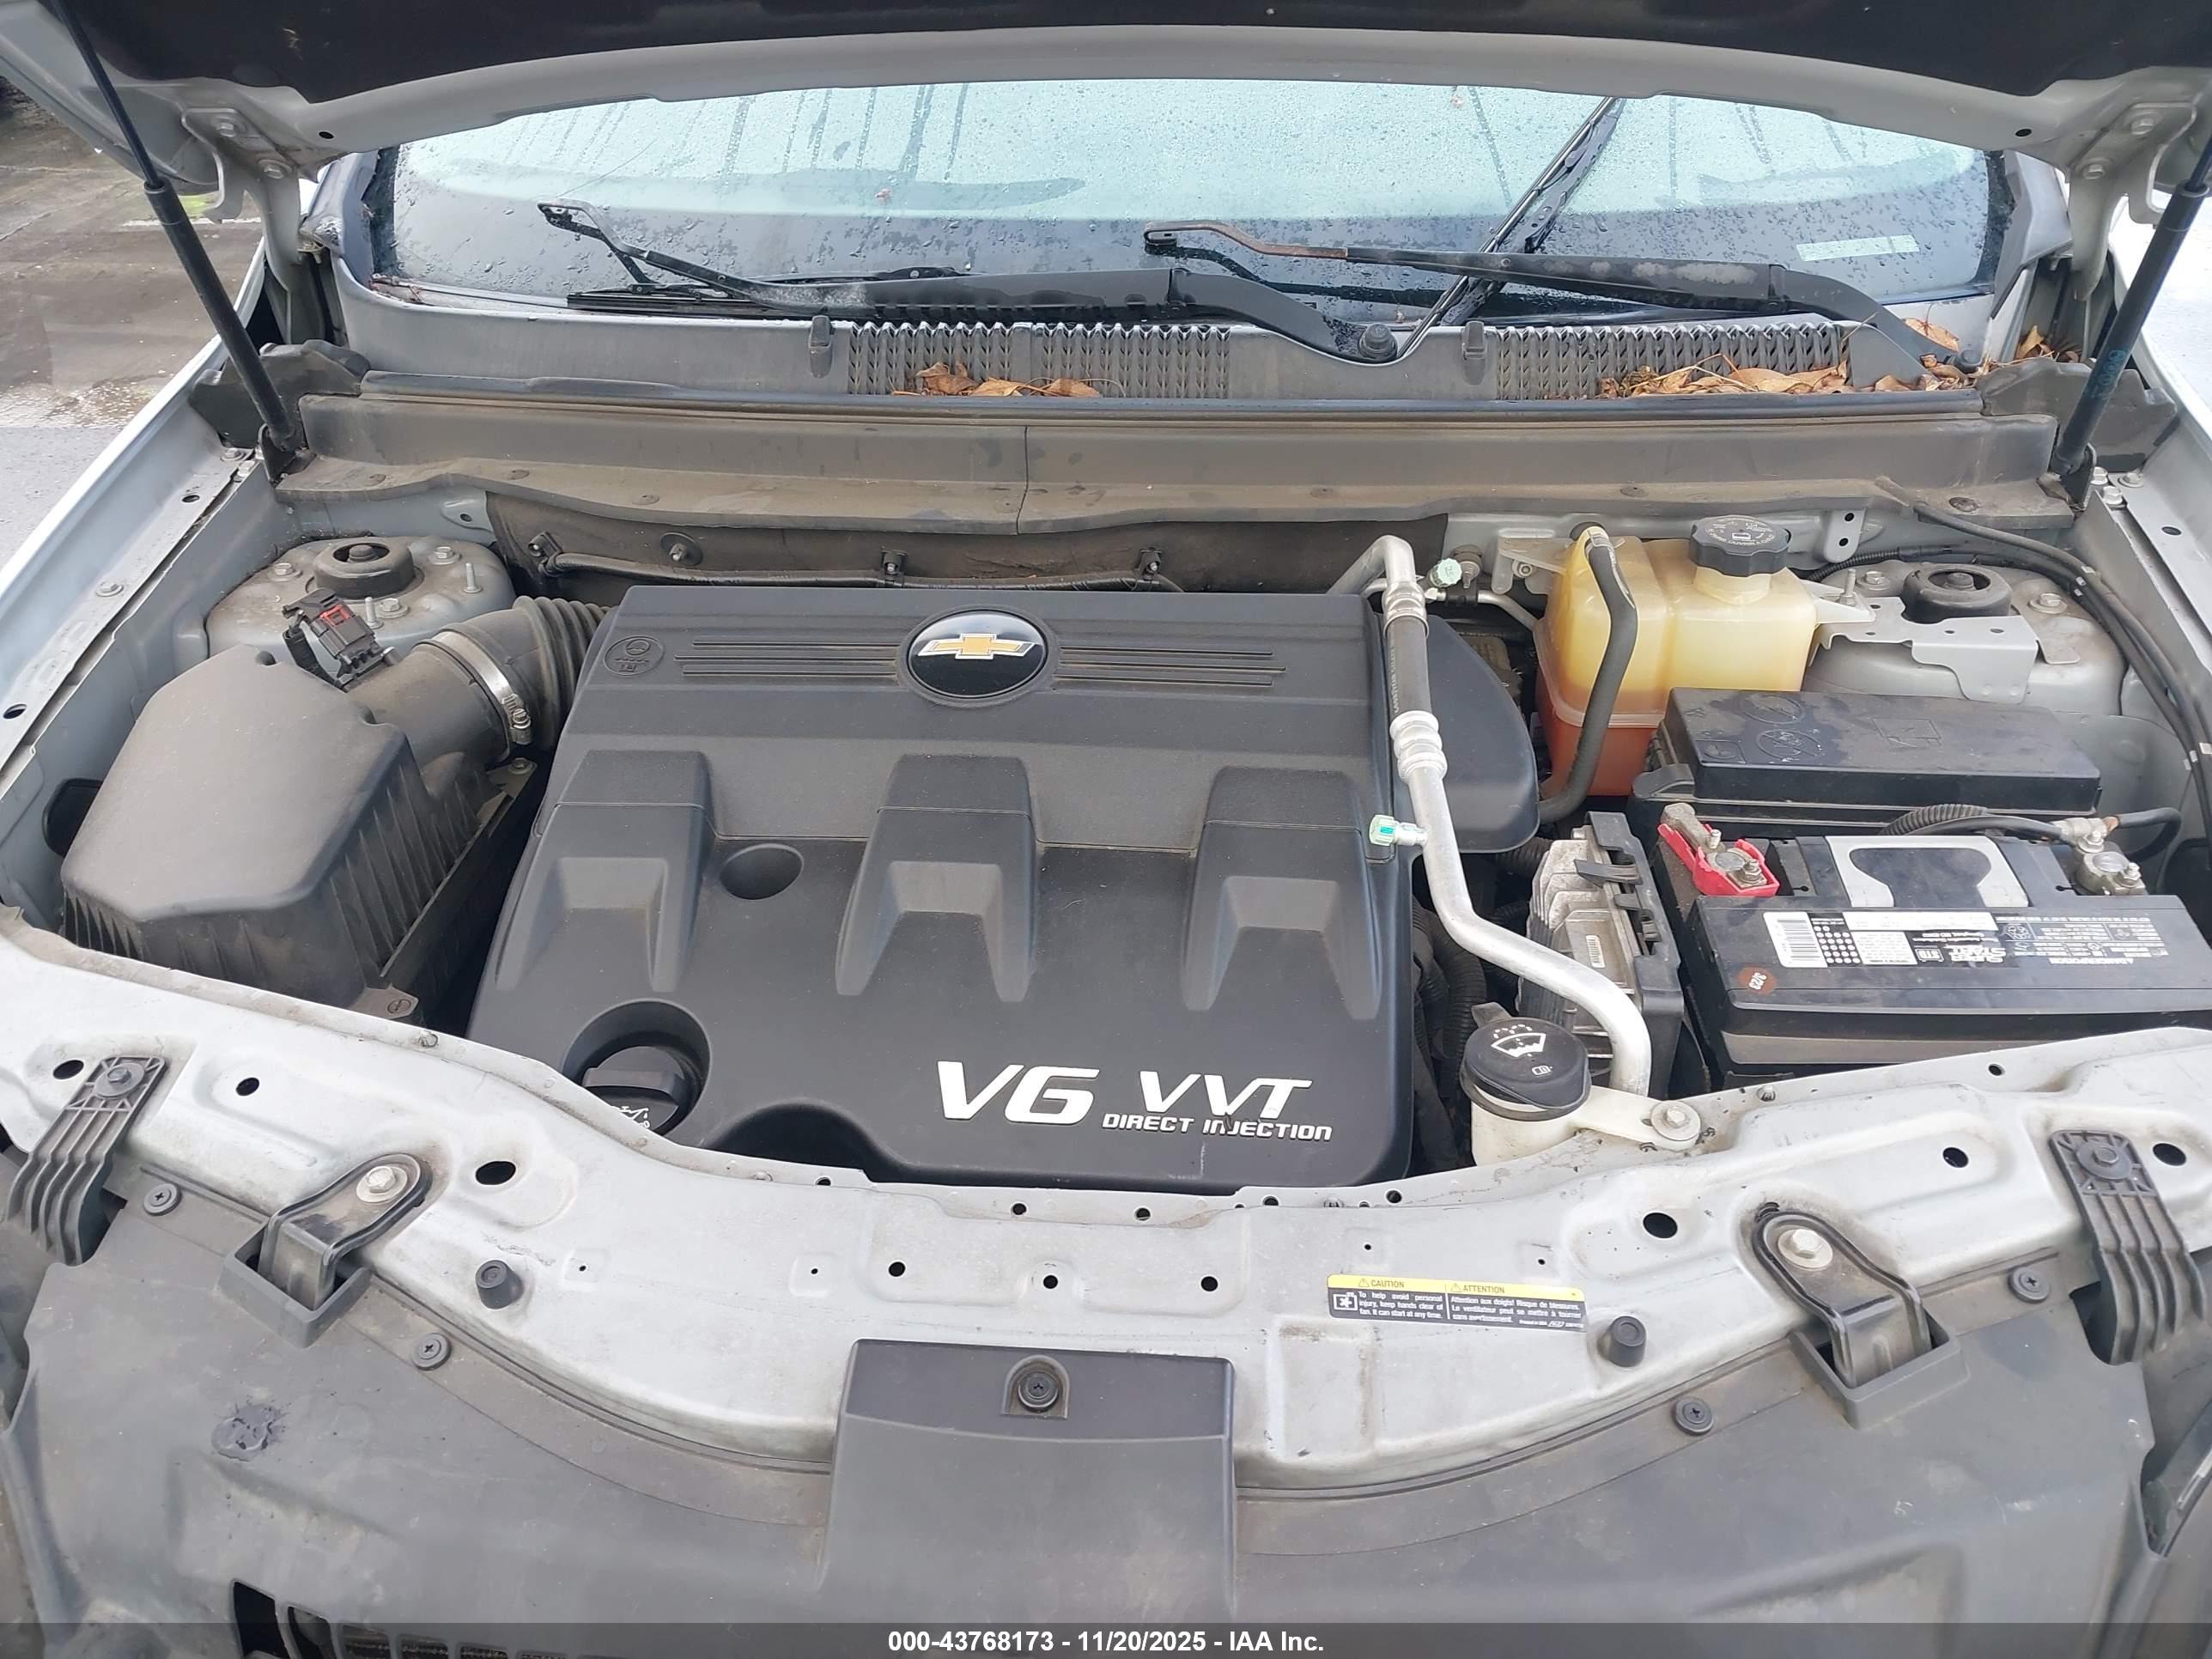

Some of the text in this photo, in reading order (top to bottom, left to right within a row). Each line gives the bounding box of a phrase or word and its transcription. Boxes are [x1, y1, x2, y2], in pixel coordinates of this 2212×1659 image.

[937, 1060, 1313, 1125] V6 VVT
[1102, 1113, 1333, 1140] DIRECT INJECTION
[1370, 1279, 1405, 1288] CAUTION
[1462, 1285, 1505, 1294] ATTENTION
[1371, 1291, 1387, 1300] help
[1451, 1296, 1479, 1304] Attention
[1379, 1301, 1396, 1310] keep
